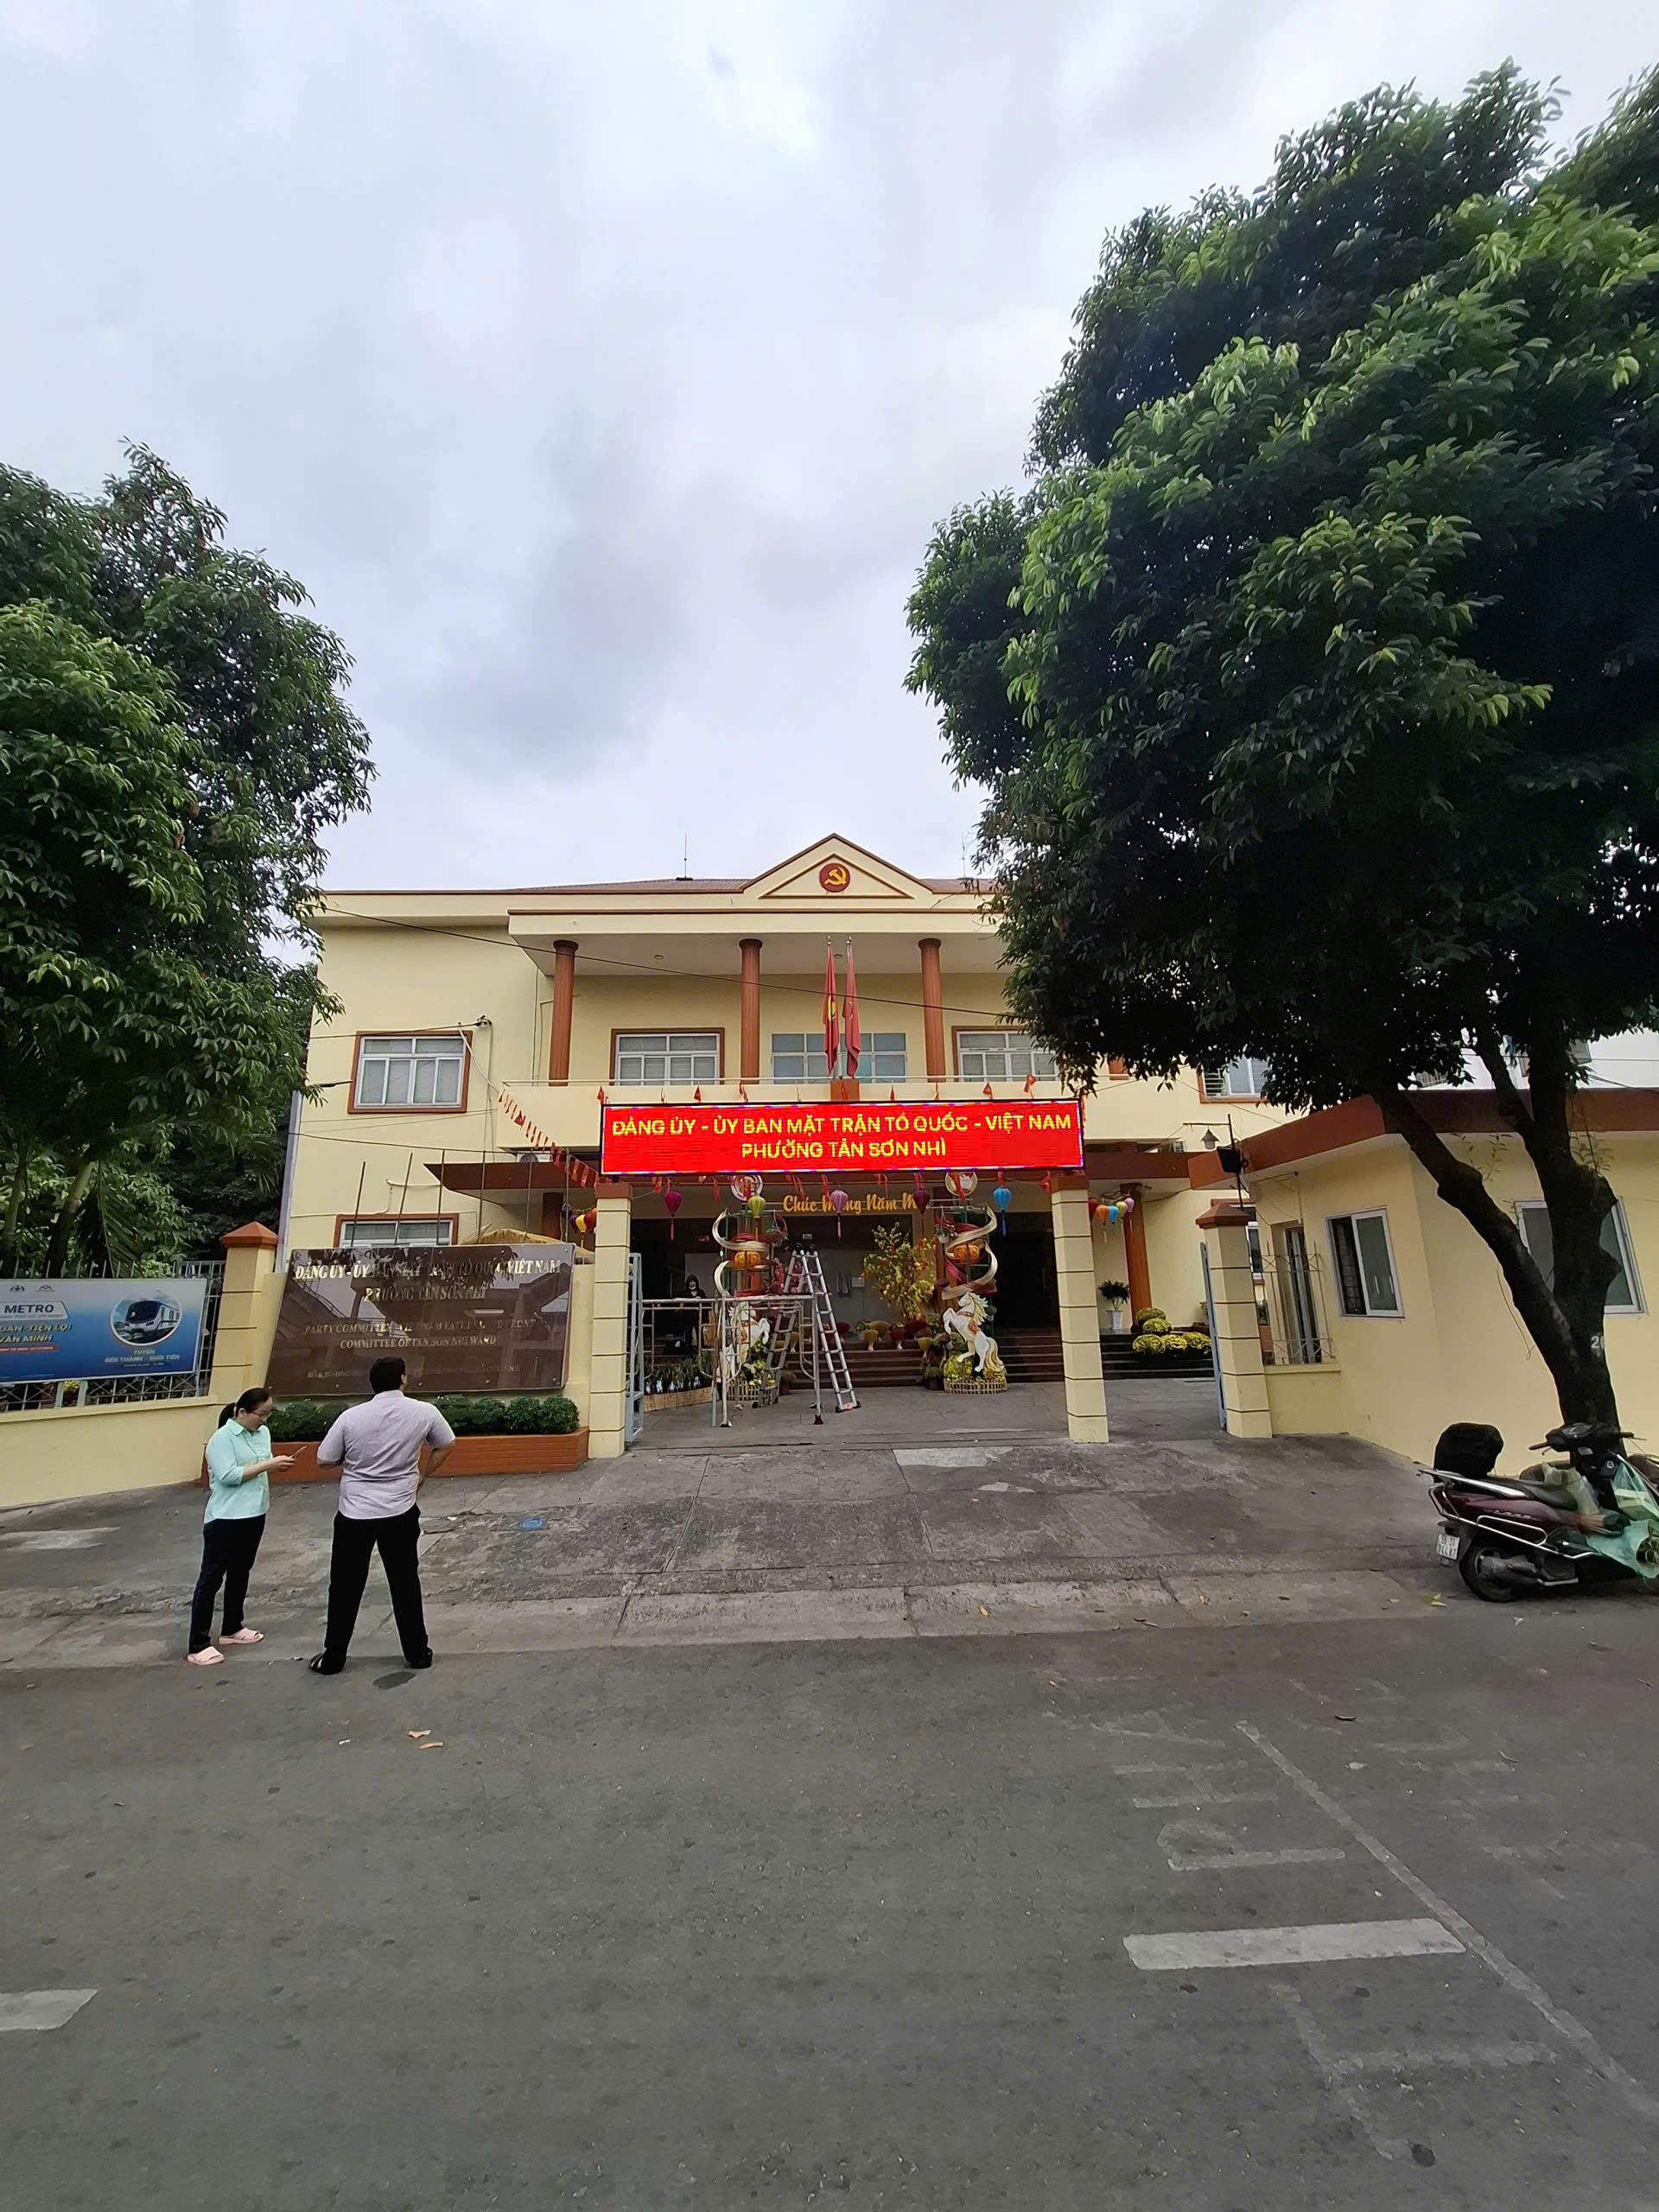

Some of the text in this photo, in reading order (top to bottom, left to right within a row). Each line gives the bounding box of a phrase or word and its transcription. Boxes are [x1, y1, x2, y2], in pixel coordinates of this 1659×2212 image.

[612, 1116, 664, 1135] ĐẢNG
[713, 1115, 739, 1135] ỦY
[743, 1118, 782, 1134] BAN
[787, 1114, 825, 1136] MẶT
[830, 1113, 880, 1136] TRẬN
[885, 1112, 909, 1132] TỔ
[913, 1111, 968, 1132] QUỐC
[985, 1112, 1024, 1134] VIỆT
[1028, 1114, 1071, 1130] NAM
[868, 1139, 909, 1157] SƠN
[783, 1194, 817, 1211] Chúc
[823, 1195, 861, 1214] Mng
[866, 1193, 898, 1211] Năm
[535, 1259, 562, 1274] NAM
[4, 1305, 54, 1313] METRO
